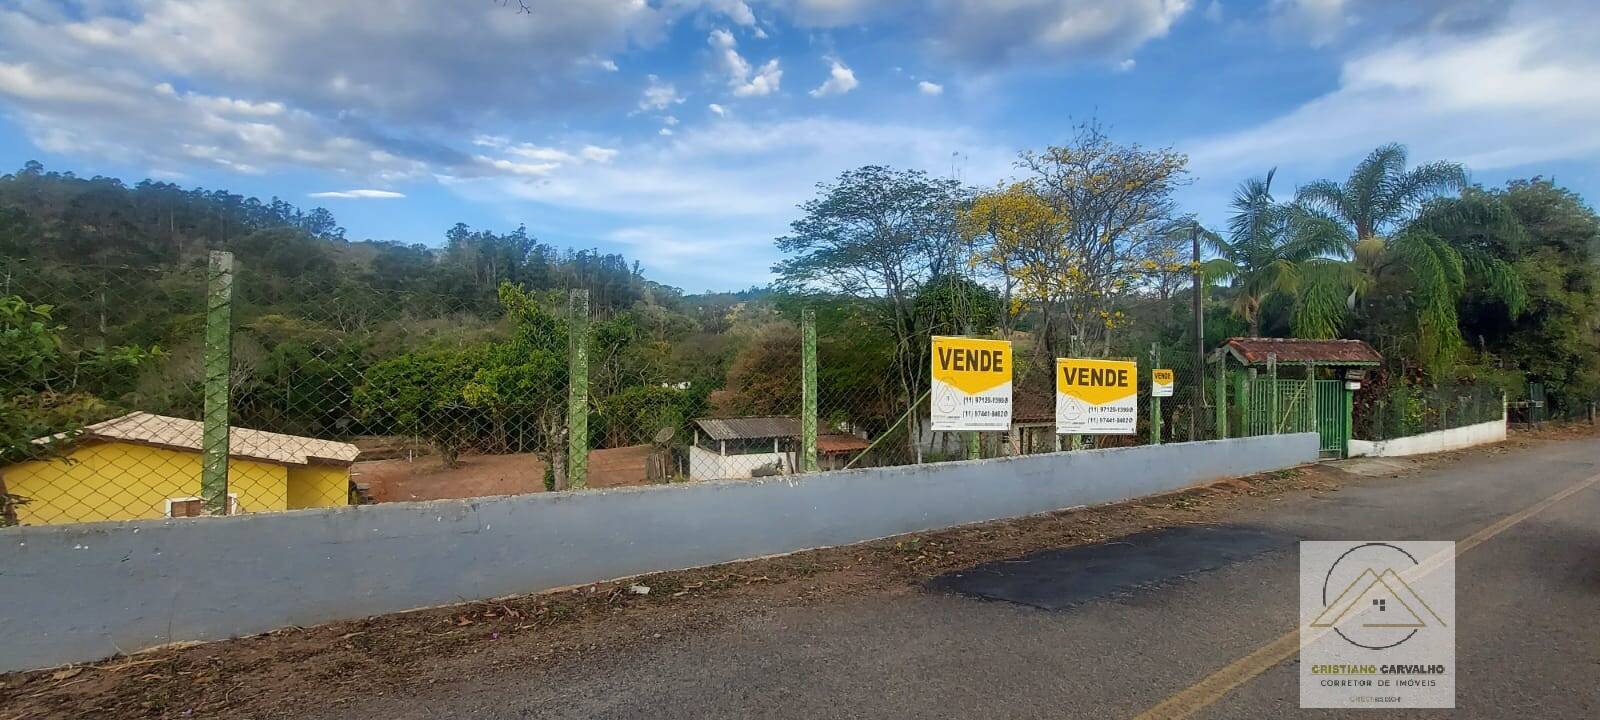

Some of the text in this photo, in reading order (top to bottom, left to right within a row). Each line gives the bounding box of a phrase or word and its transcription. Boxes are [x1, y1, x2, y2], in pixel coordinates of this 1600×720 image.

[937, 346, 1004, 373] VENDE
[1063, 366, 1129, 388] VENDE
[1154, 372, 1172, 380] VENDE
